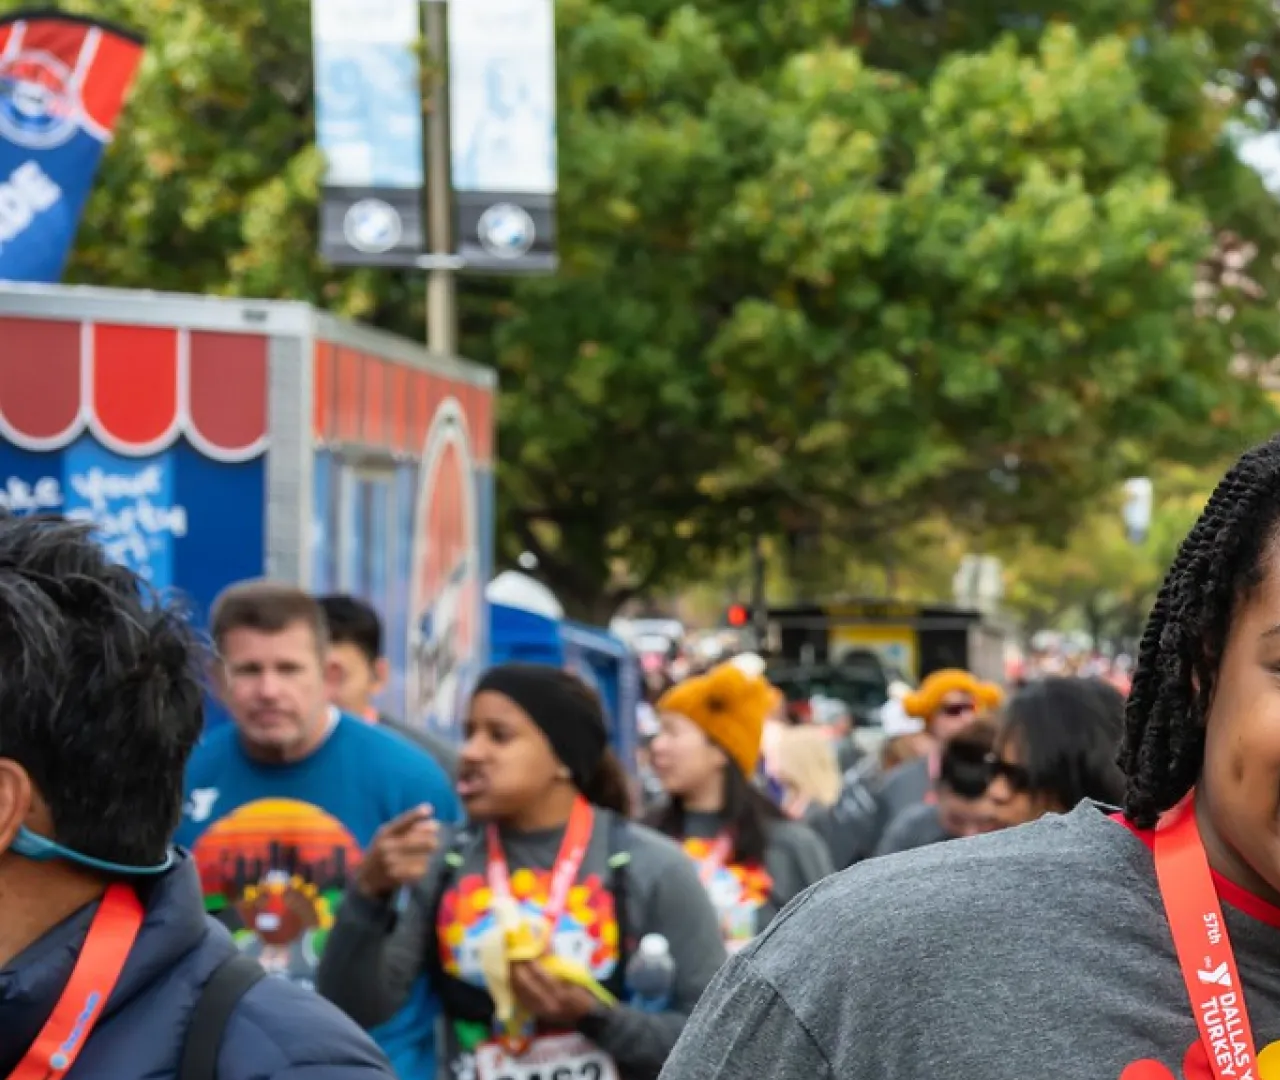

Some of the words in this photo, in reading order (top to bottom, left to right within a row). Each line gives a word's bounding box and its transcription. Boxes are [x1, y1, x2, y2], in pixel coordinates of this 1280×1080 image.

[1203, 912, 1221, 945] 57th
[1201, 996, 1236, 1077] TURKEY
[1219, 991, 1251, 1068] DALLAS
